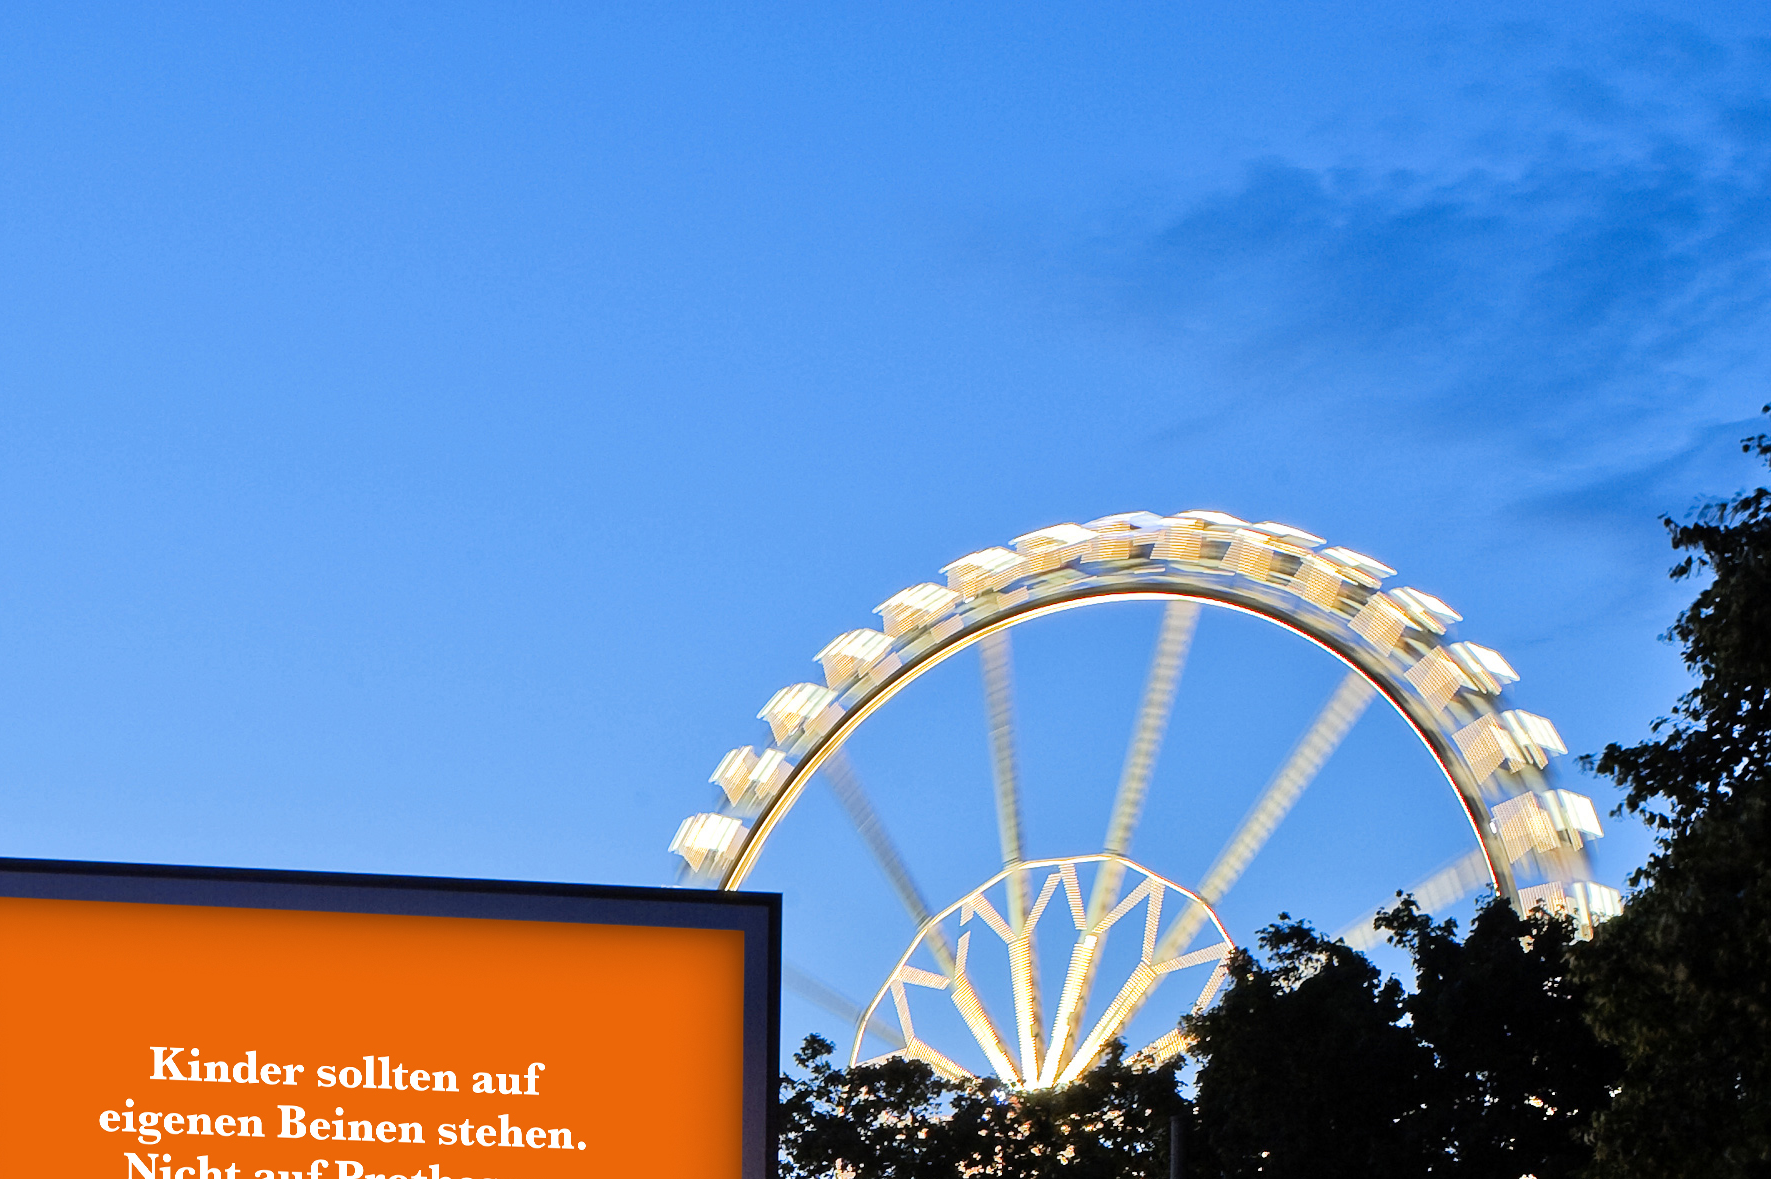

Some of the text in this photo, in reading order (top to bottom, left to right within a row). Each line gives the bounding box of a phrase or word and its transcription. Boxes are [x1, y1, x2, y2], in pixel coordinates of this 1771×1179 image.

[150, 1047, 545, 1095] Kinder sollten auf
[99, 1099, 586, 1150] eigenen Beinen stehen.
